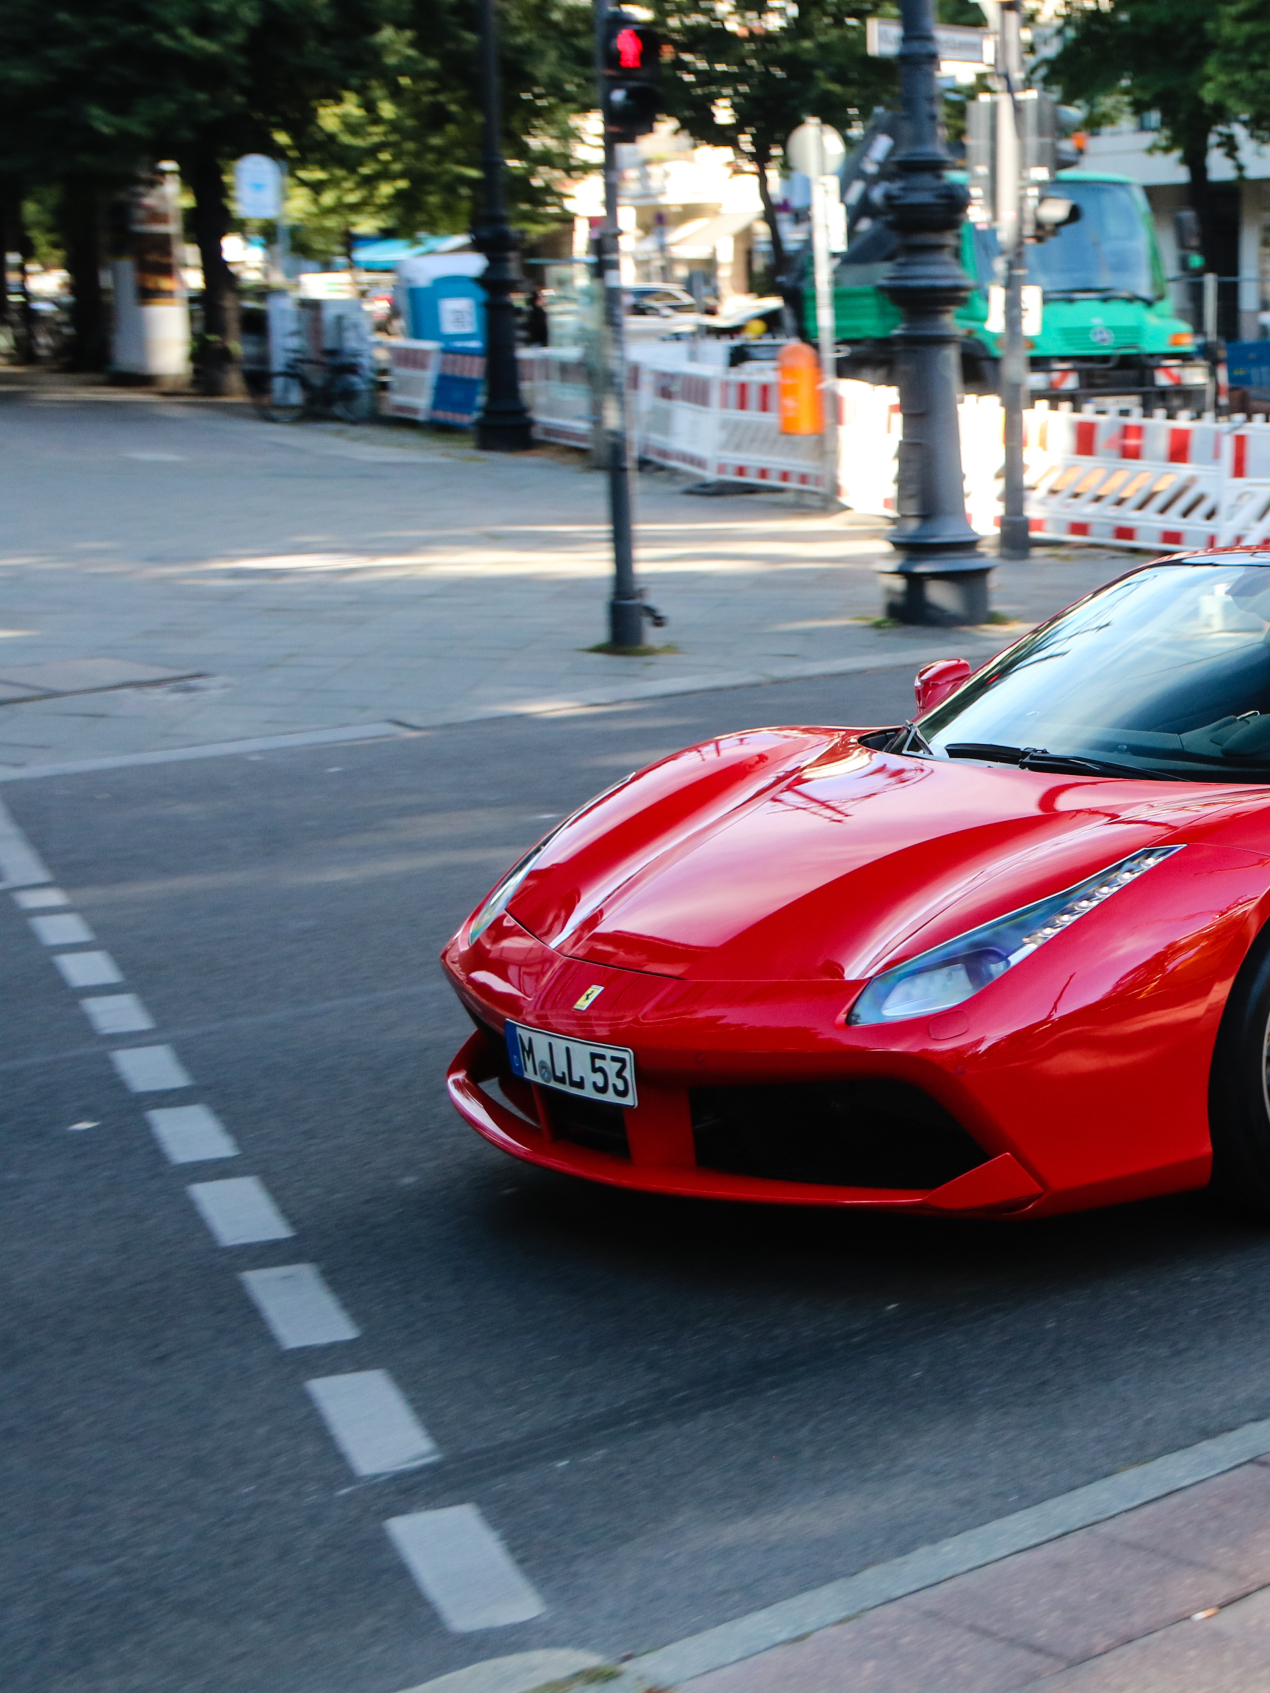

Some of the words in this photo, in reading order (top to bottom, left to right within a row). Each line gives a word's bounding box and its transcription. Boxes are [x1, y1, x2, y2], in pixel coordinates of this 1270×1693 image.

[518, 1033, 538, 1076] M
[548, 1041, 585, 1090] LL
[589, 1051, 629, 1098] 53
